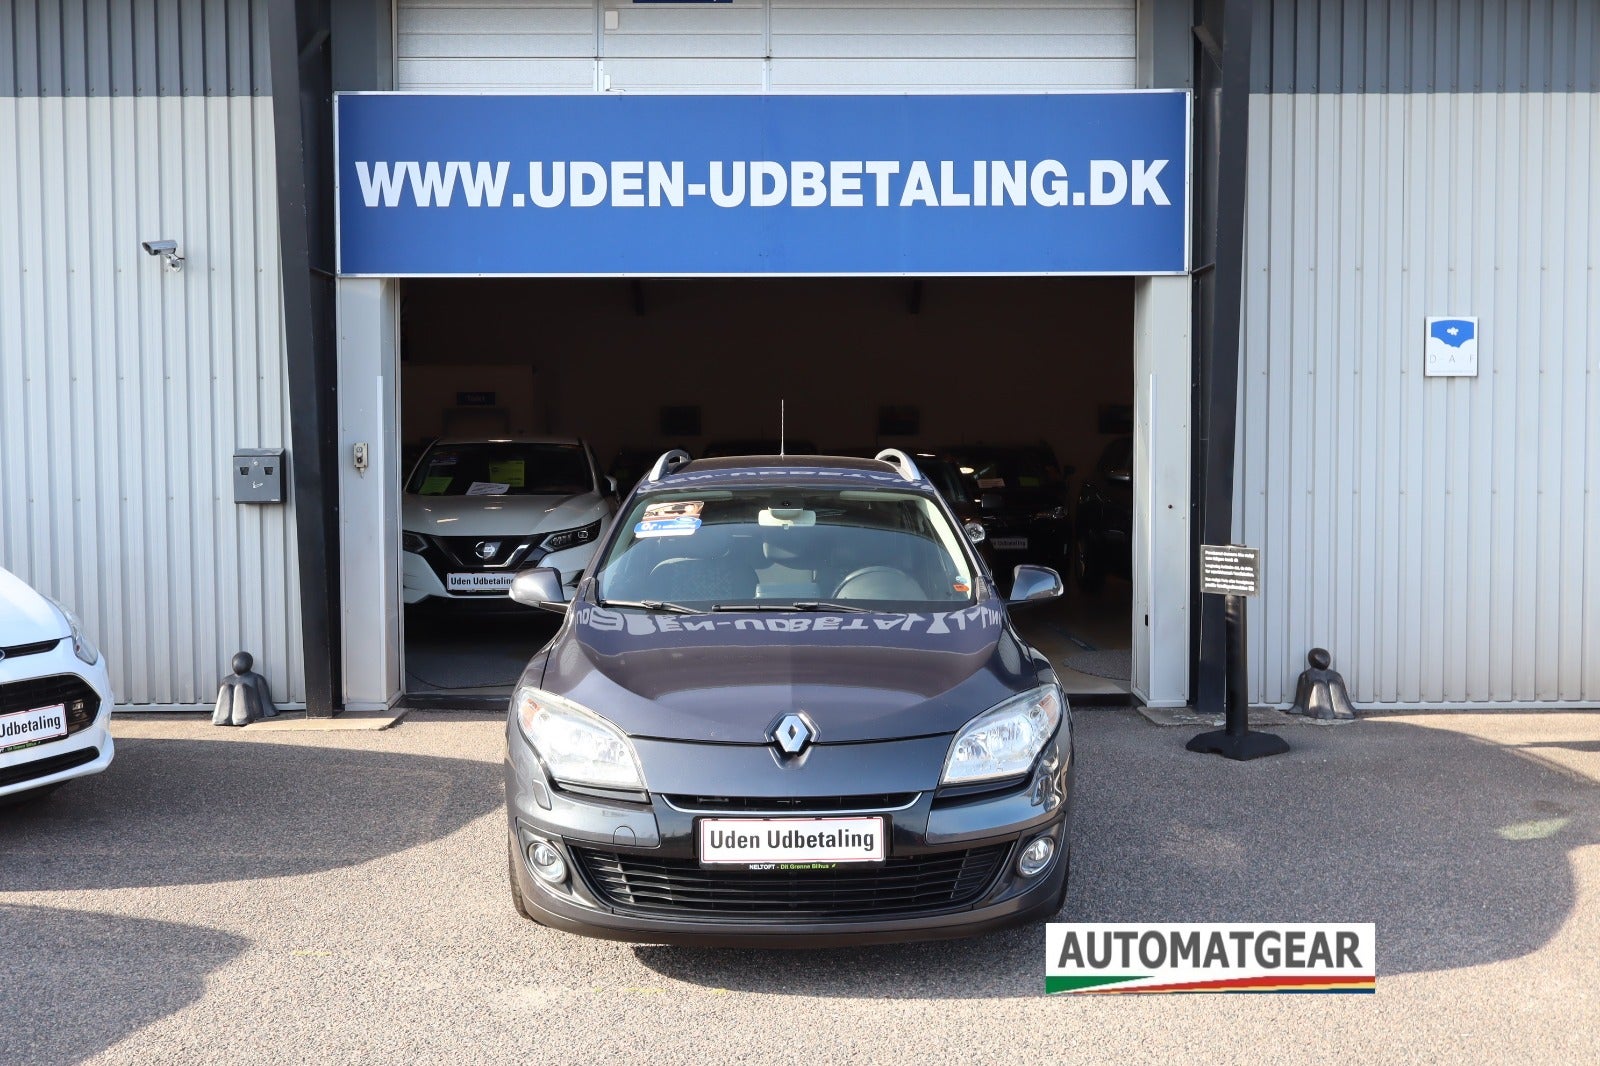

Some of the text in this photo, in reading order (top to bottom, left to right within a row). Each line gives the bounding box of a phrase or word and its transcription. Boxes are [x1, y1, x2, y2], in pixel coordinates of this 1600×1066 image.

[355, 158, 1172, 209] WWW.UDEN-UDBETALING.DK
[450, 577, 471, 585] Uden
[710, 829, 875, 851] Uden Udbetaling
